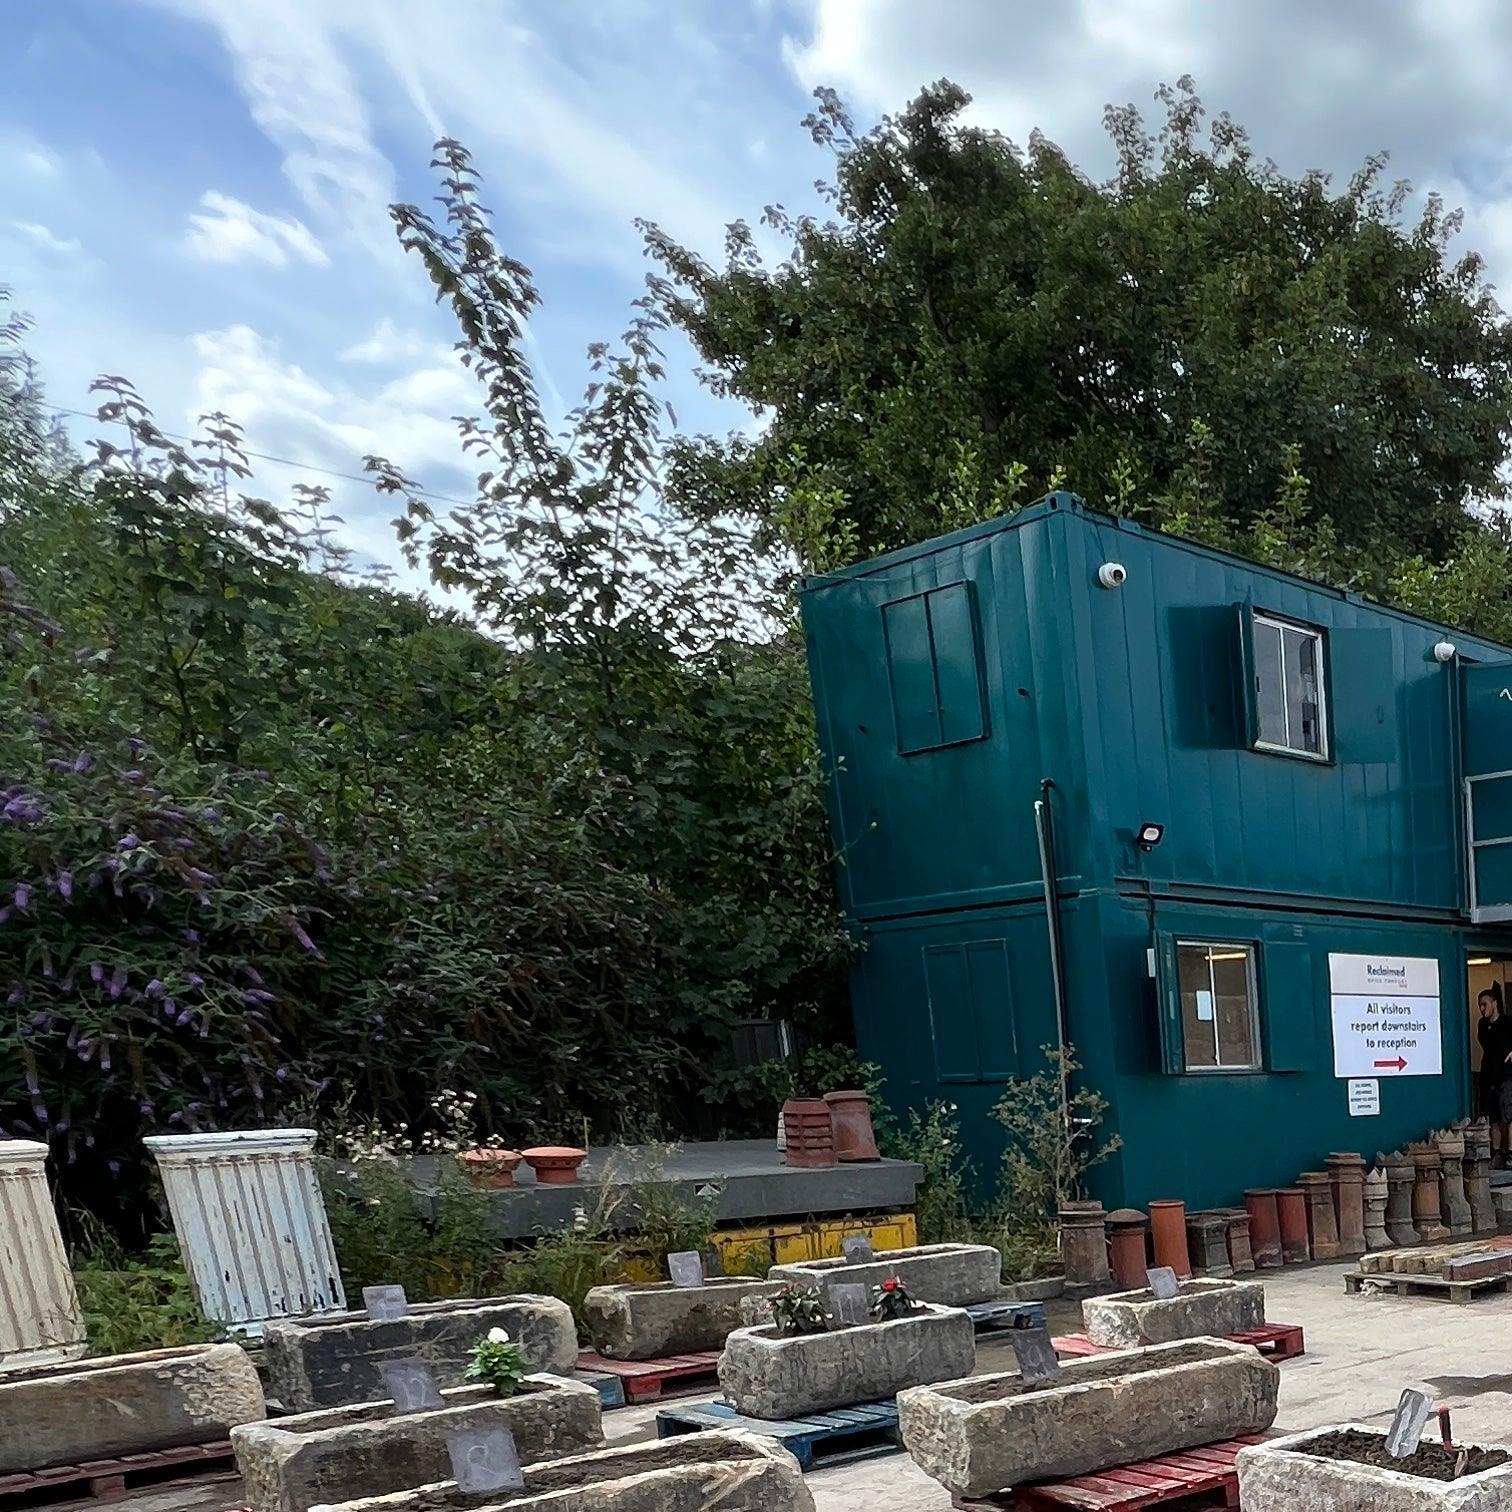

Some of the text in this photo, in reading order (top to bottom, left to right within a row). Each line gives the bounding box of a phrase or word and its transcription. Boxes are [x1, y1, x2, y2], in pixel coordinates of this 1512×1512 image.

[1367, 964, 1406, 977] Reclaimed
[1366, 1002, 1412, 1015] All visitors
[1350, 1019, 1427, 1034] report downstairs
[1366, 1036, 1417, 1051] to reception
